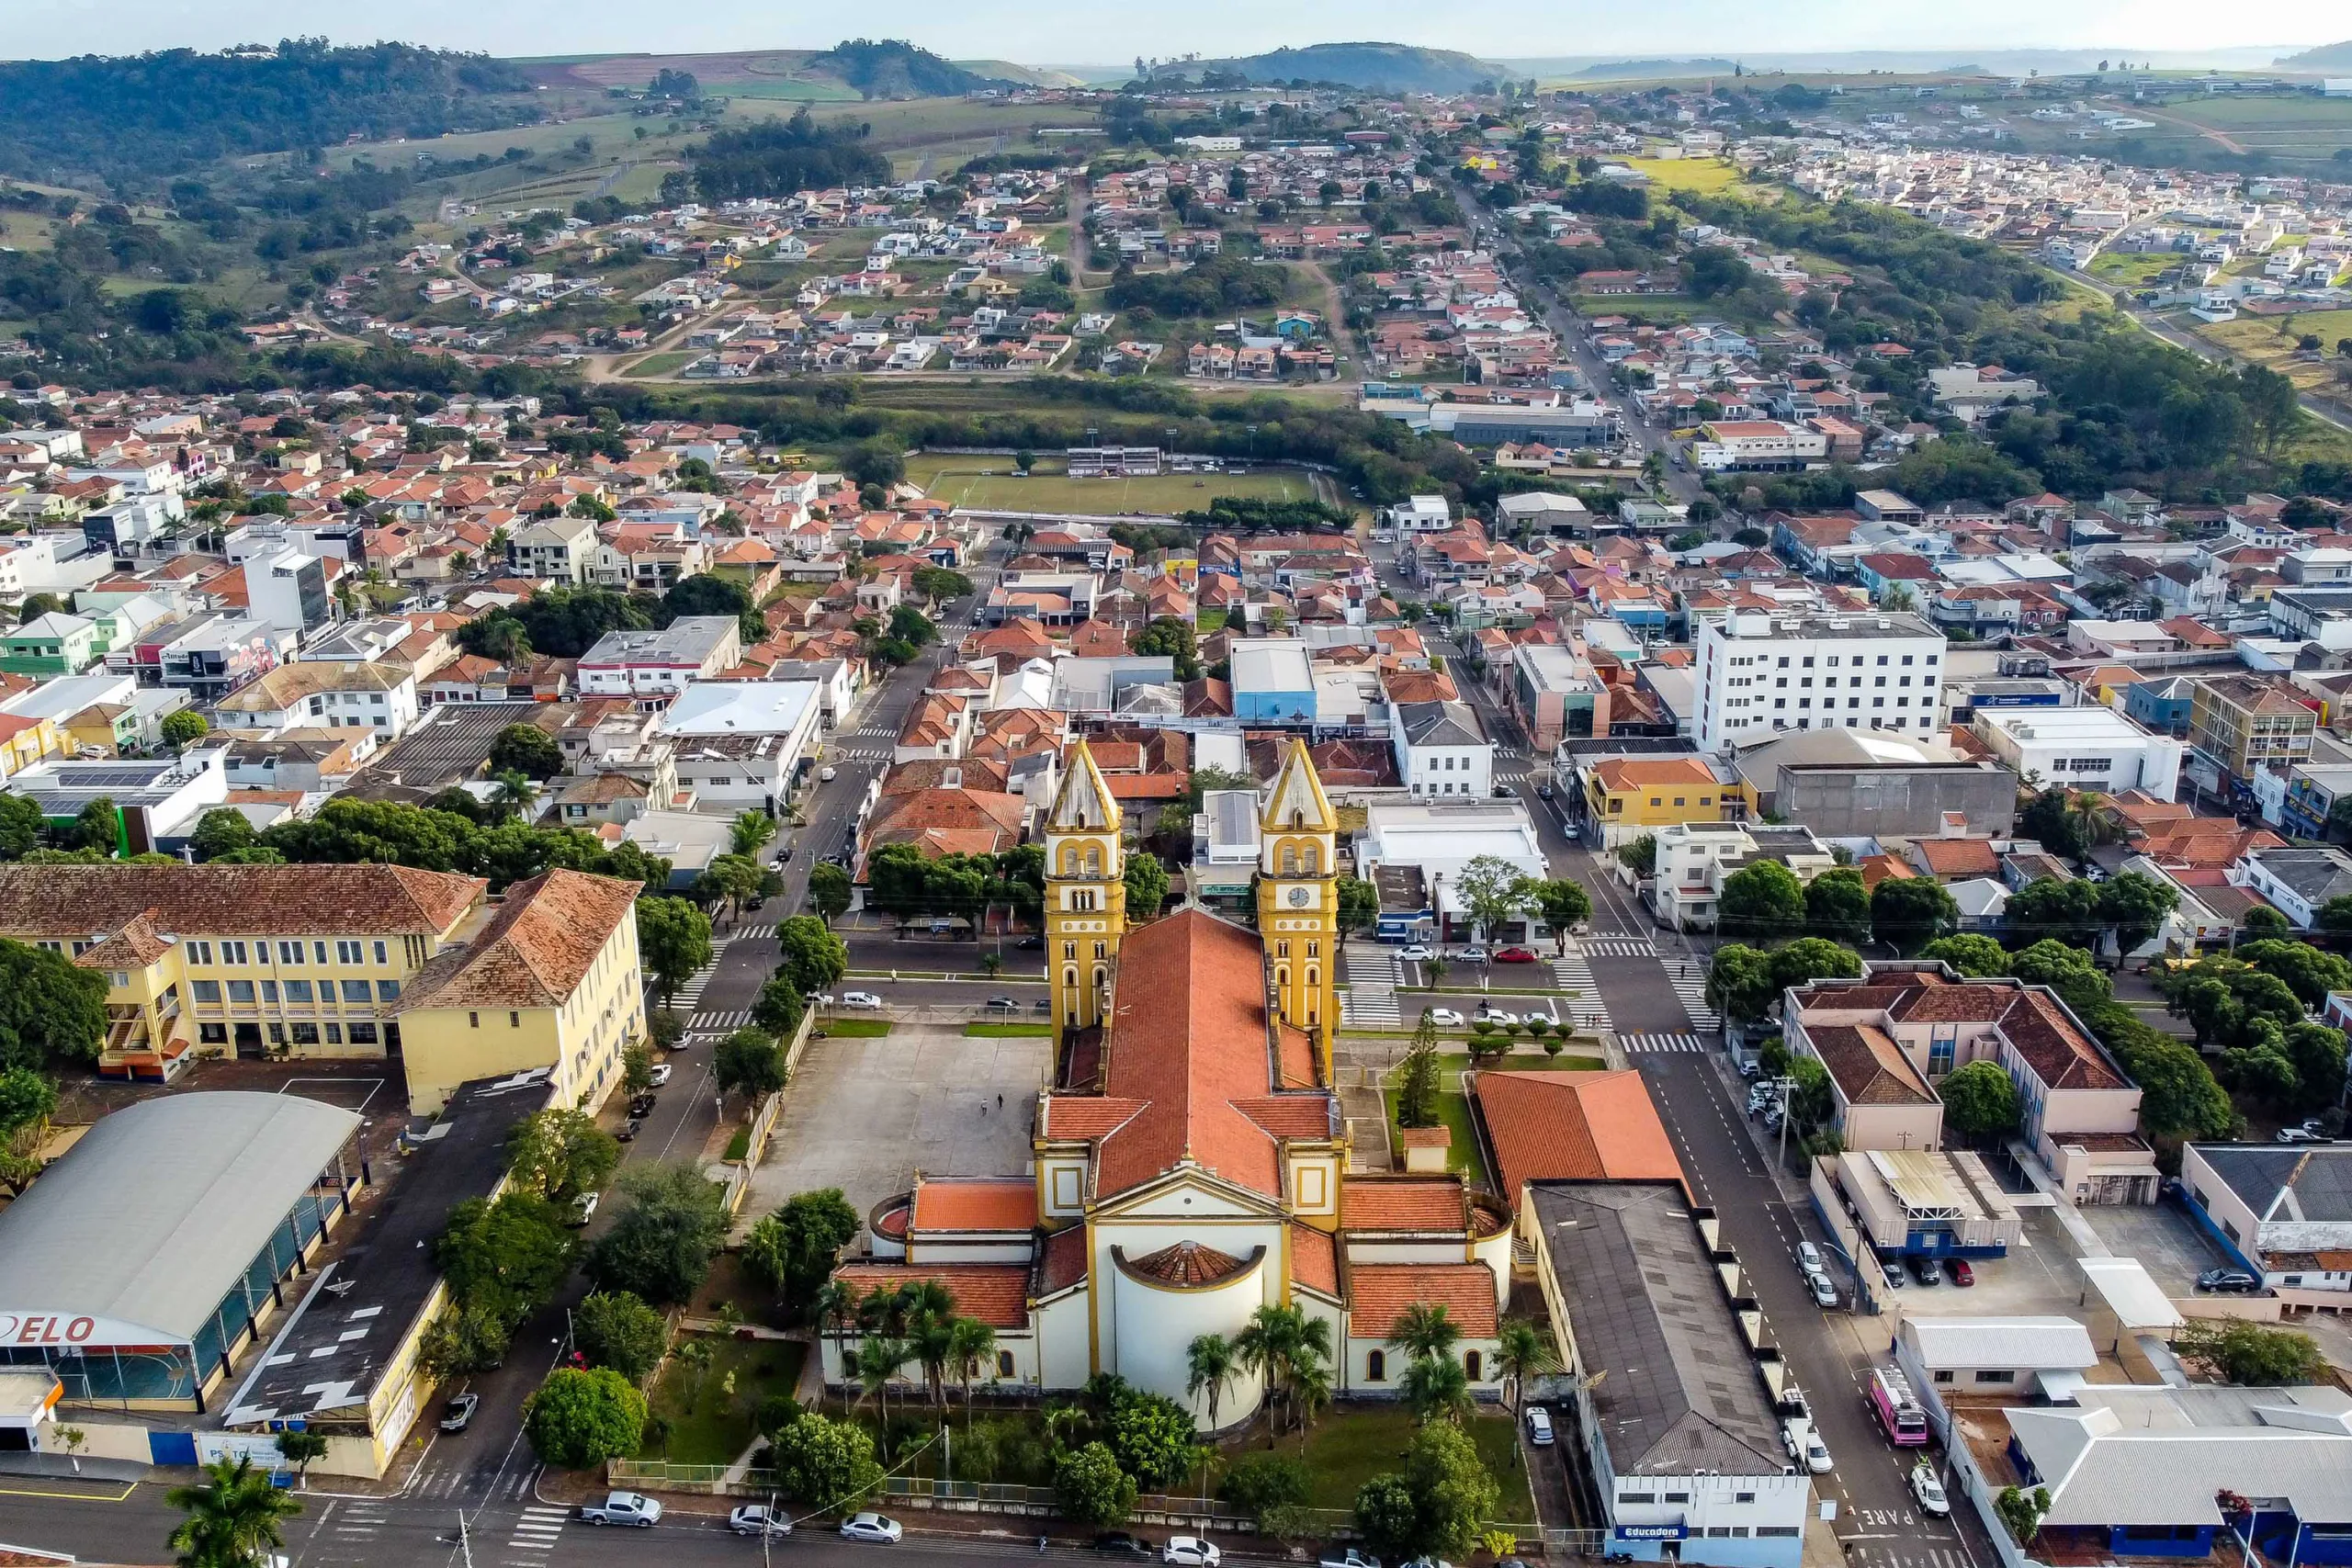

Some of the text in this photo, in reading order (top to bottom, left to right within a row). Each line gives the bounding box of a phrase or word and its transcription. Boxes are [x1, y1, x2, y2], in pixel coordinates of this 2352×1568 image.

[17, 1316, 95, 1343] ELO
[1861, 1509, 1915, 1526] PARE
[1625, 1528, 1679, 1537] Educadora
